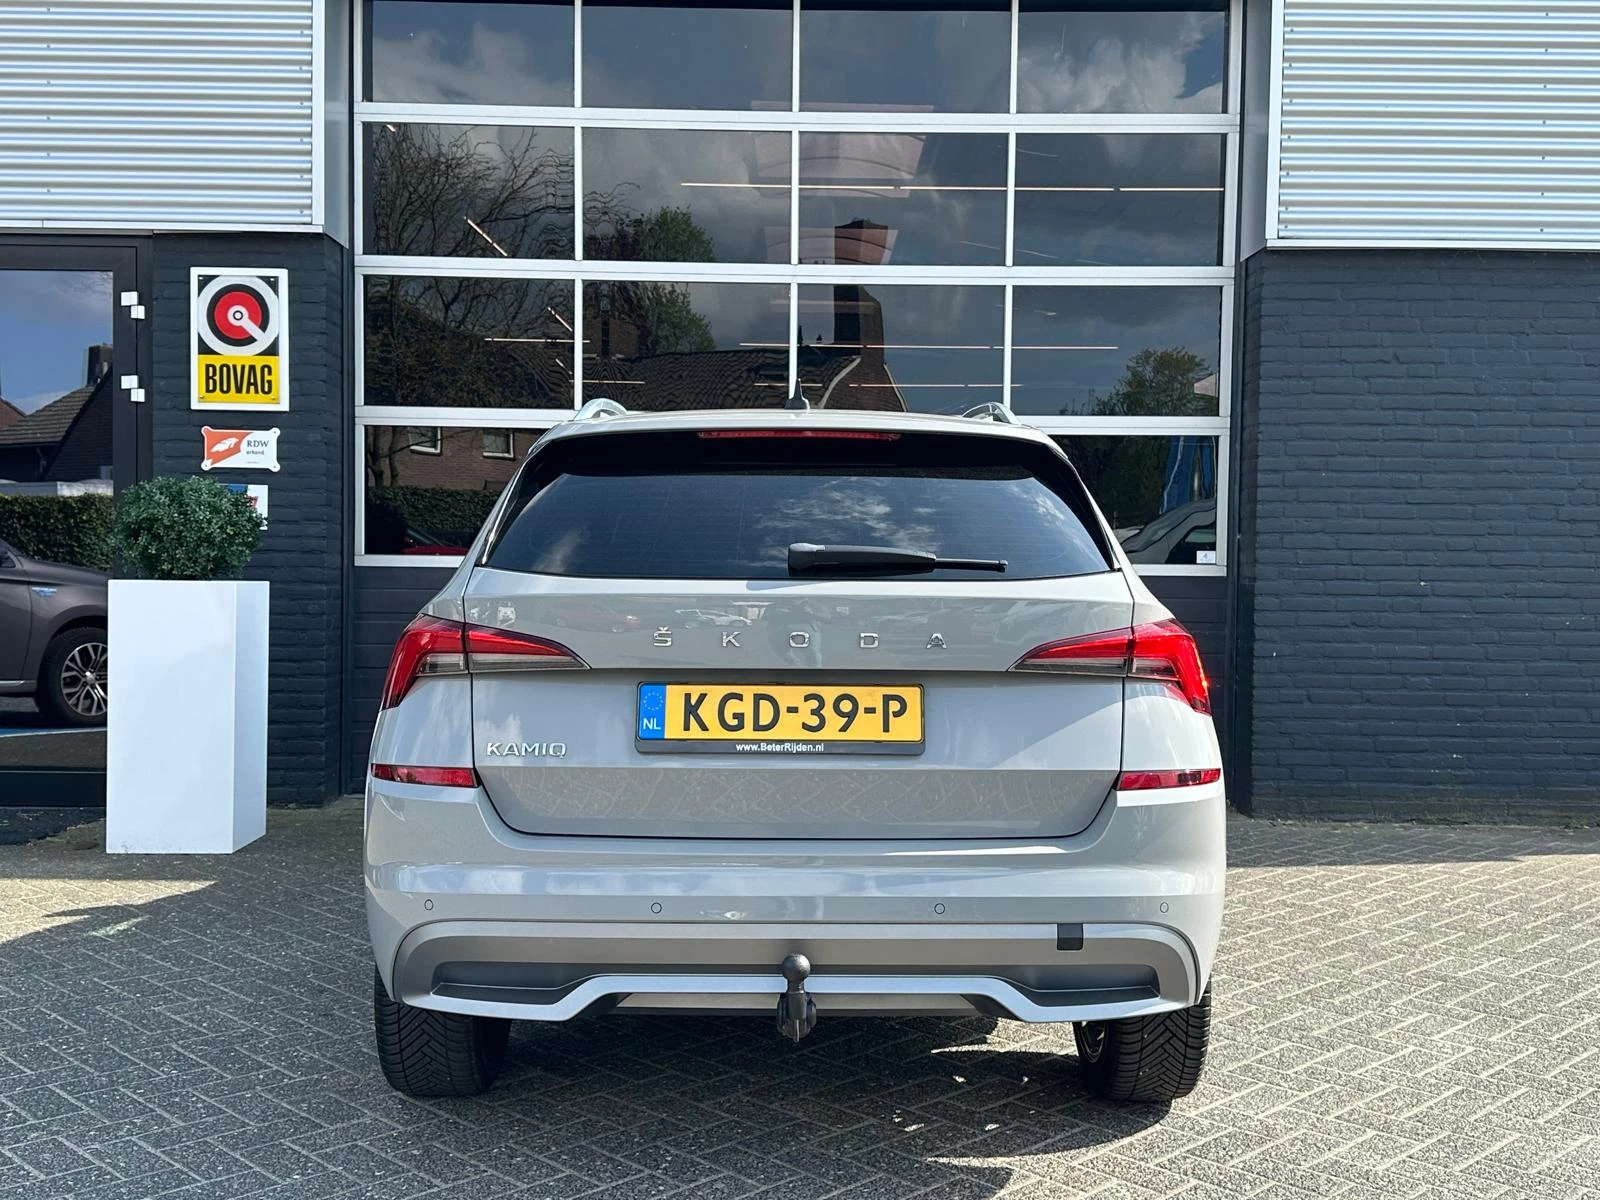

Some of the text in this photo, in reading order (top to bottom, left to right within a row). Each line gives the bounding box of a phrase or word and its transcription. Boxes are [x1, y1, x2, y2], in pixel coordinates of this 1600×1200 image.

[205, 363, 272, 395] BOVAG
[247, 440, 269, 448] RDW
[653, 626, 948, 649] ŠKODA
[682, 692, 908, 733] KGD-39-P
[642, 718, 661, 730] NL
[486, 742, 567, 759] KAMIQ
[735, 742, 825, 754] www.BeterRijden.nl
